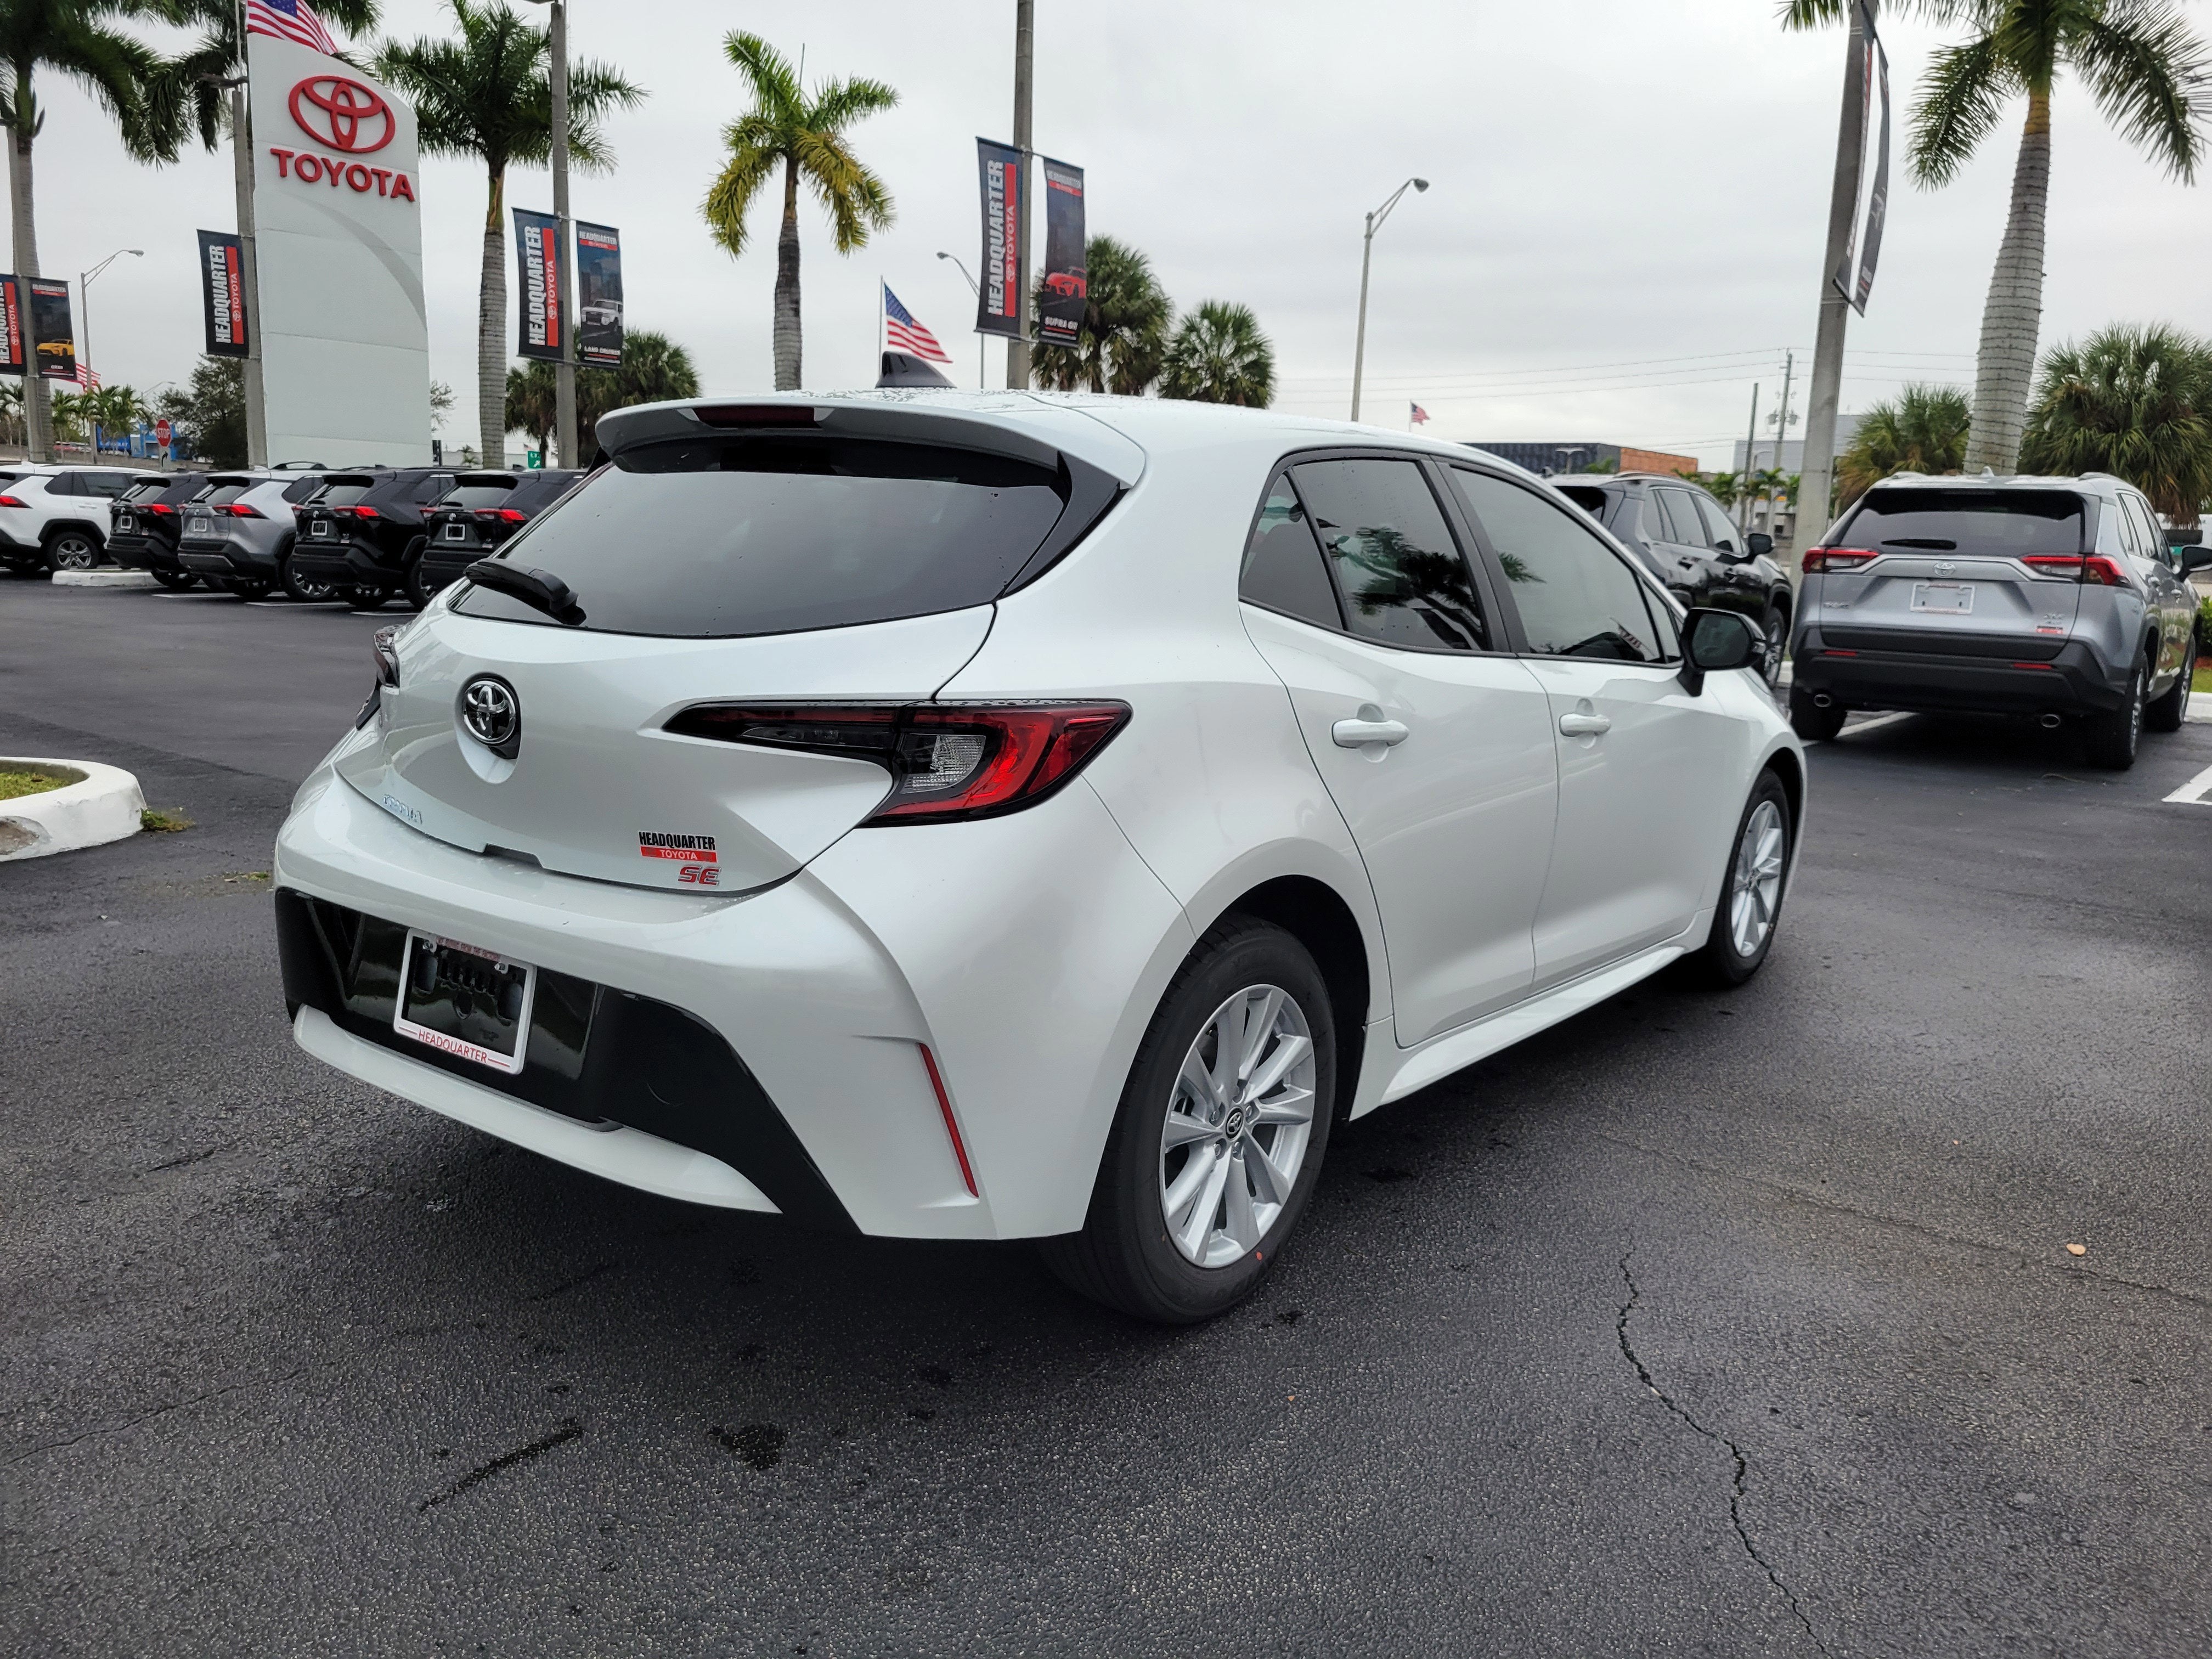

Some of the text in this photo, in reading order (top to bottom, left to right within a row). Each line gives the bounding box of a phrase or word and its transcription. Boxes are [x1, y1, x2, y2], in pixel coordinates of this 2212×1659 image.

[270, 148, 415, 202] TOYOTA
[988, 159, 1006, 316] HEADQUARTER
[1006, 205, 1015, 262] TOYOTA
[209, 245, 231, 343] HEADQUARTER
[230, 273, 240, 309] TOYOTA
[524, 225, 546, 346] HEADQUARTER
[547, 261, 556, 303] TOYOTA
[9, 304, 18, 335] TOYOTA
[157, 427, 170, 438] STOP
[639, 831, 715, 850] HEADQUARTER
[659, 849, 697, 860] TOYOTA
[678, 865, 721, 885] SE
[419, 1029, 487, 1063] HEADQUARTER
